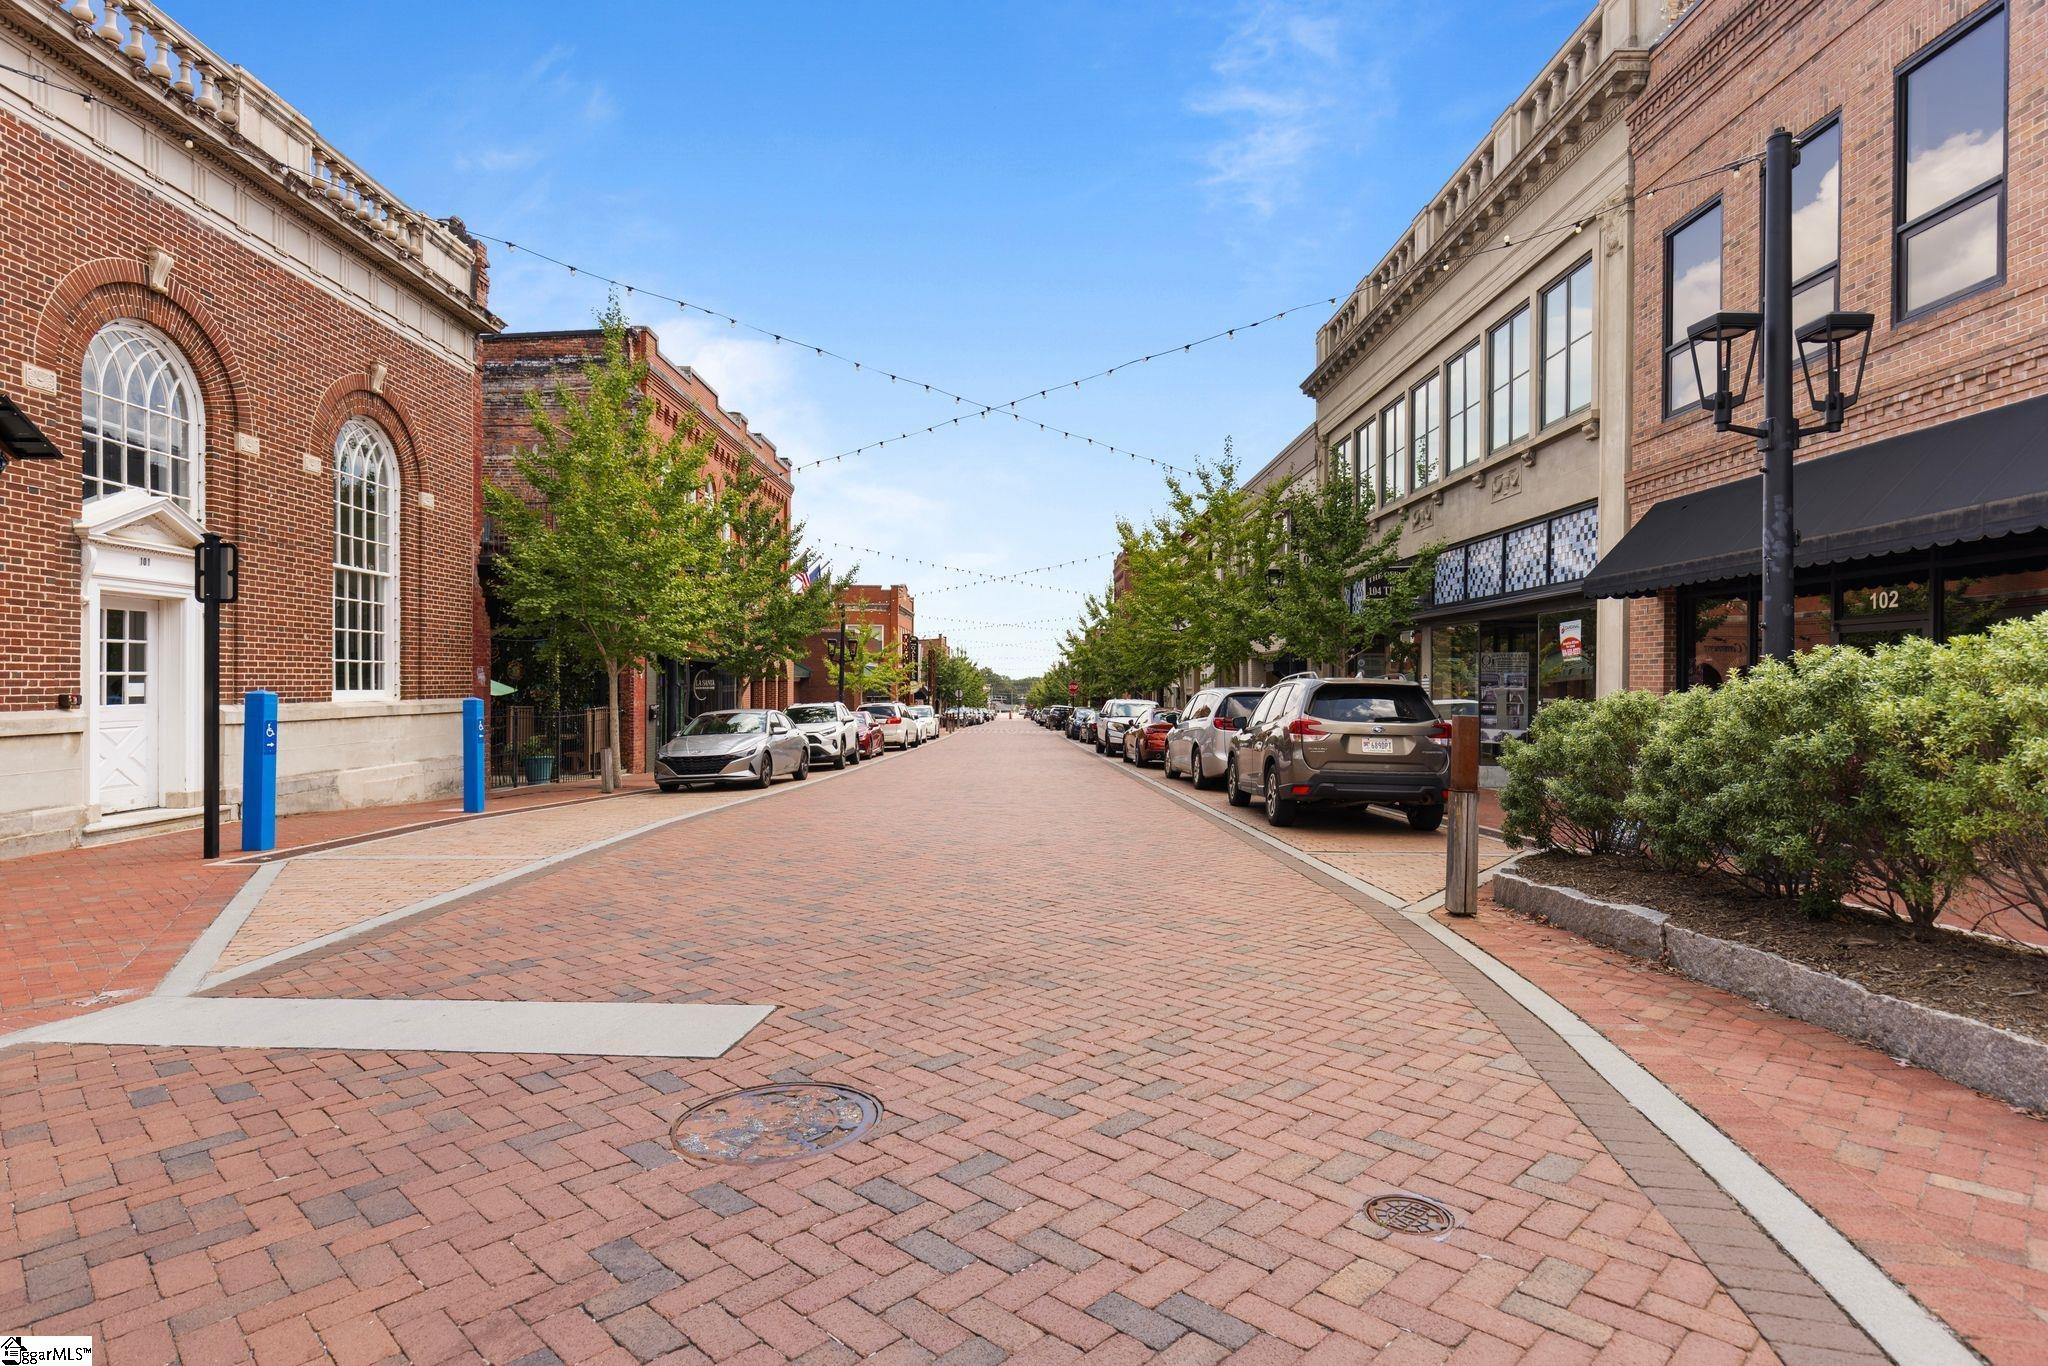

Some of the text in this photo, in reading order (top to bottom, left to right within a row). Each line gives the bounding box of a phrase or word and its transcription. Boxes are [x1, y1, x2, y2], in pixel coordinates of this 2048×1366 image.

[140, 557, 151, 566] 101
[1368, 586, 1382, 596] 104
[1870, 590, 1899, 609] 102
